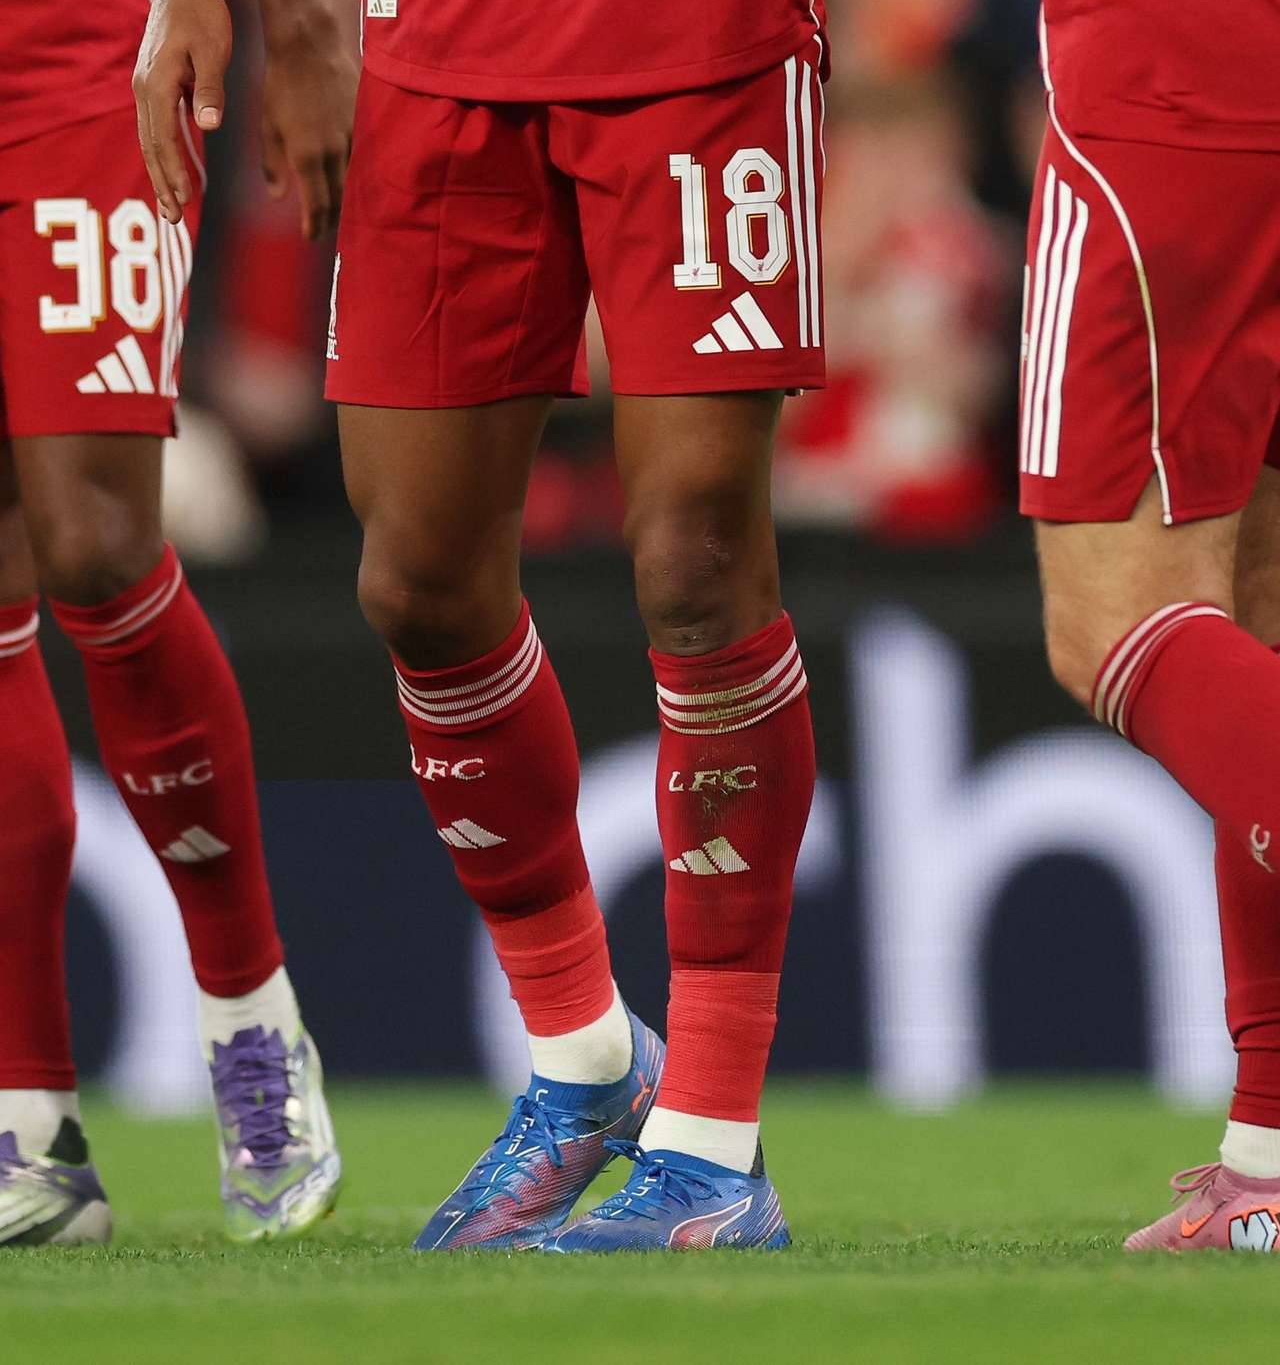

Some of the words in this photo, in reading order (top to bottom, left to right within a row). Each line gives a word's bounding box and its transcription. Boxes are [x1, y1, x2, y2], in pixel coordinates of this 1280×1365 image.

[669, 146, 793, 291] 18
[34, 197, 163, 334] 38
[122, 758, 214, 795] LFC
[409, 743, 486, 782] LFC
[668, 764, 758, 792] LFC
